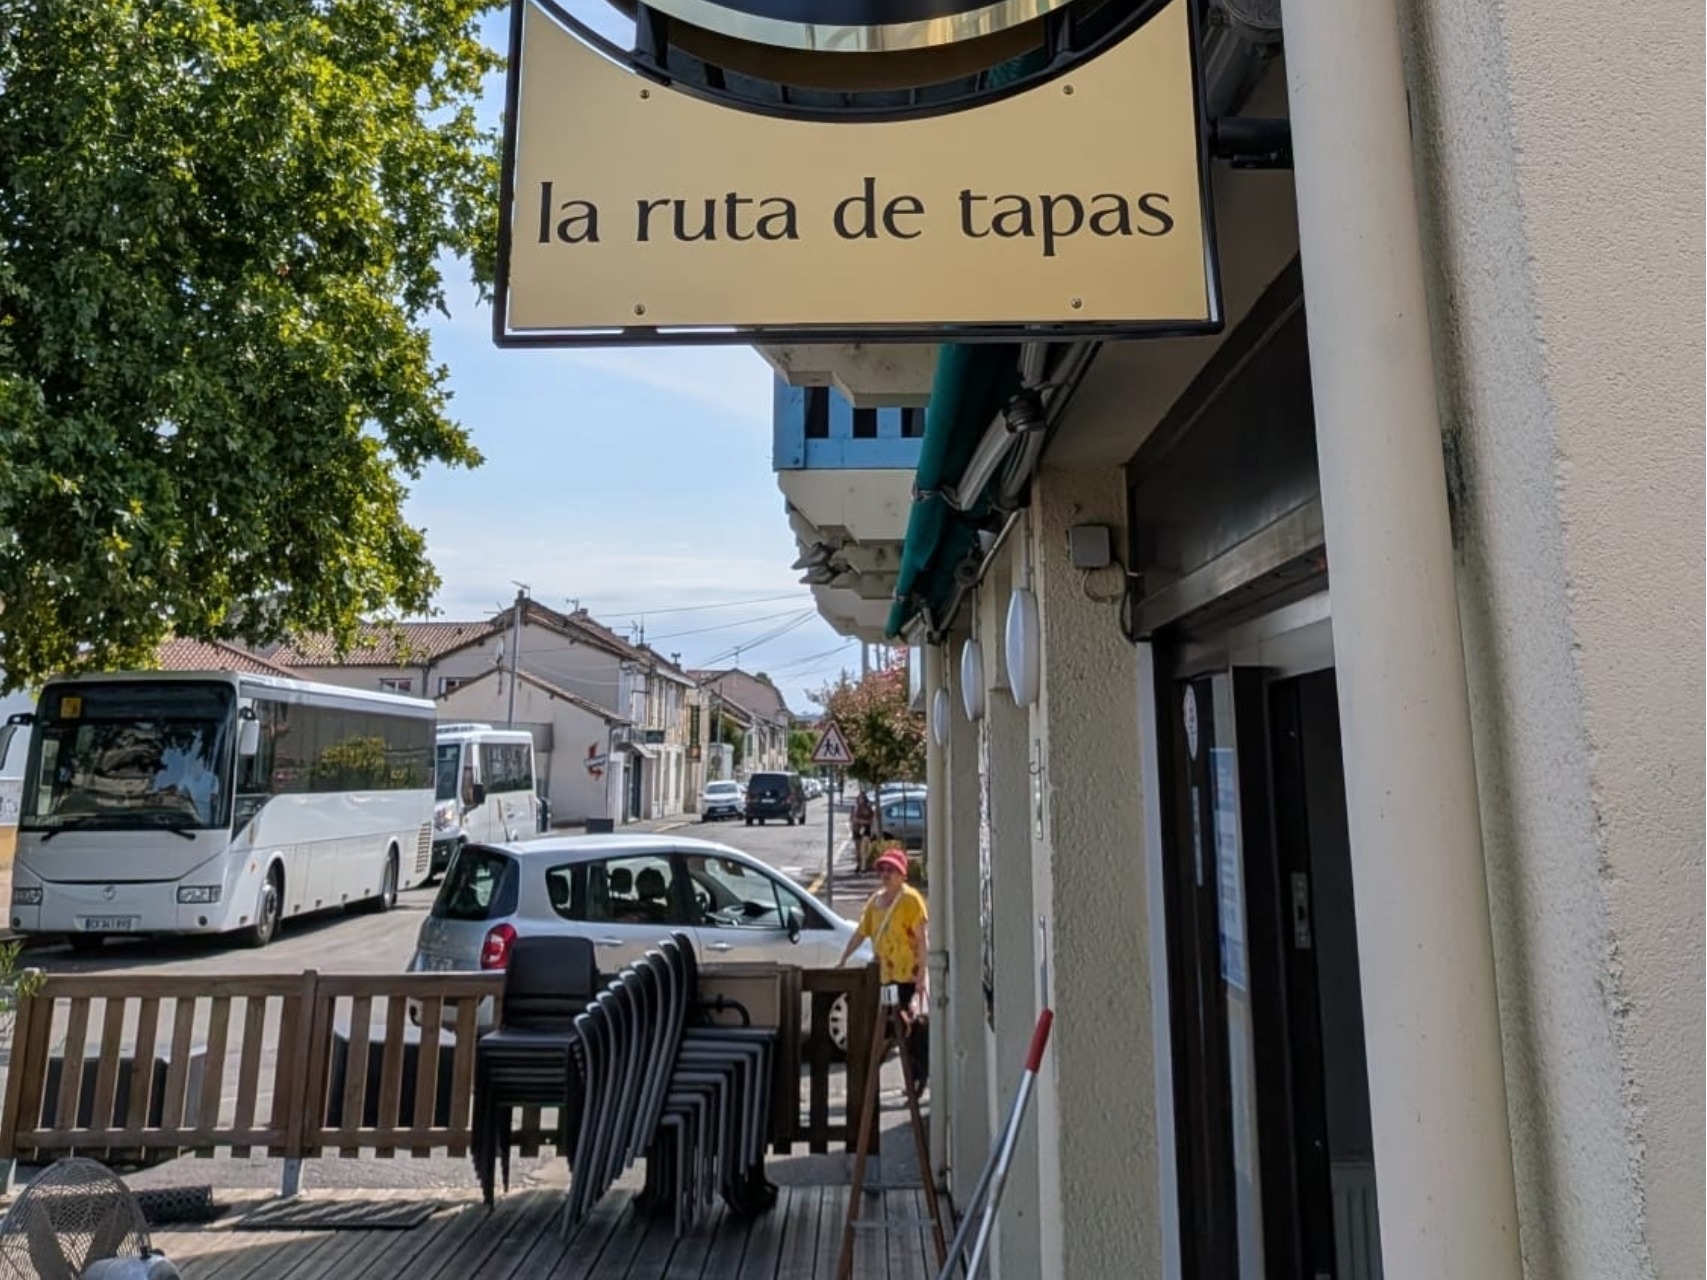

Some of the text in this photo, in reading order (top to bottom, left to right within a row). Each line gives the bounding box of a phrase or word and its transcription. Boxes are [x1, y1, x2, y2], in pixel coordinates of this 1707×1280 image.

[538, 176, 1174, 257] la ruta de tapas
